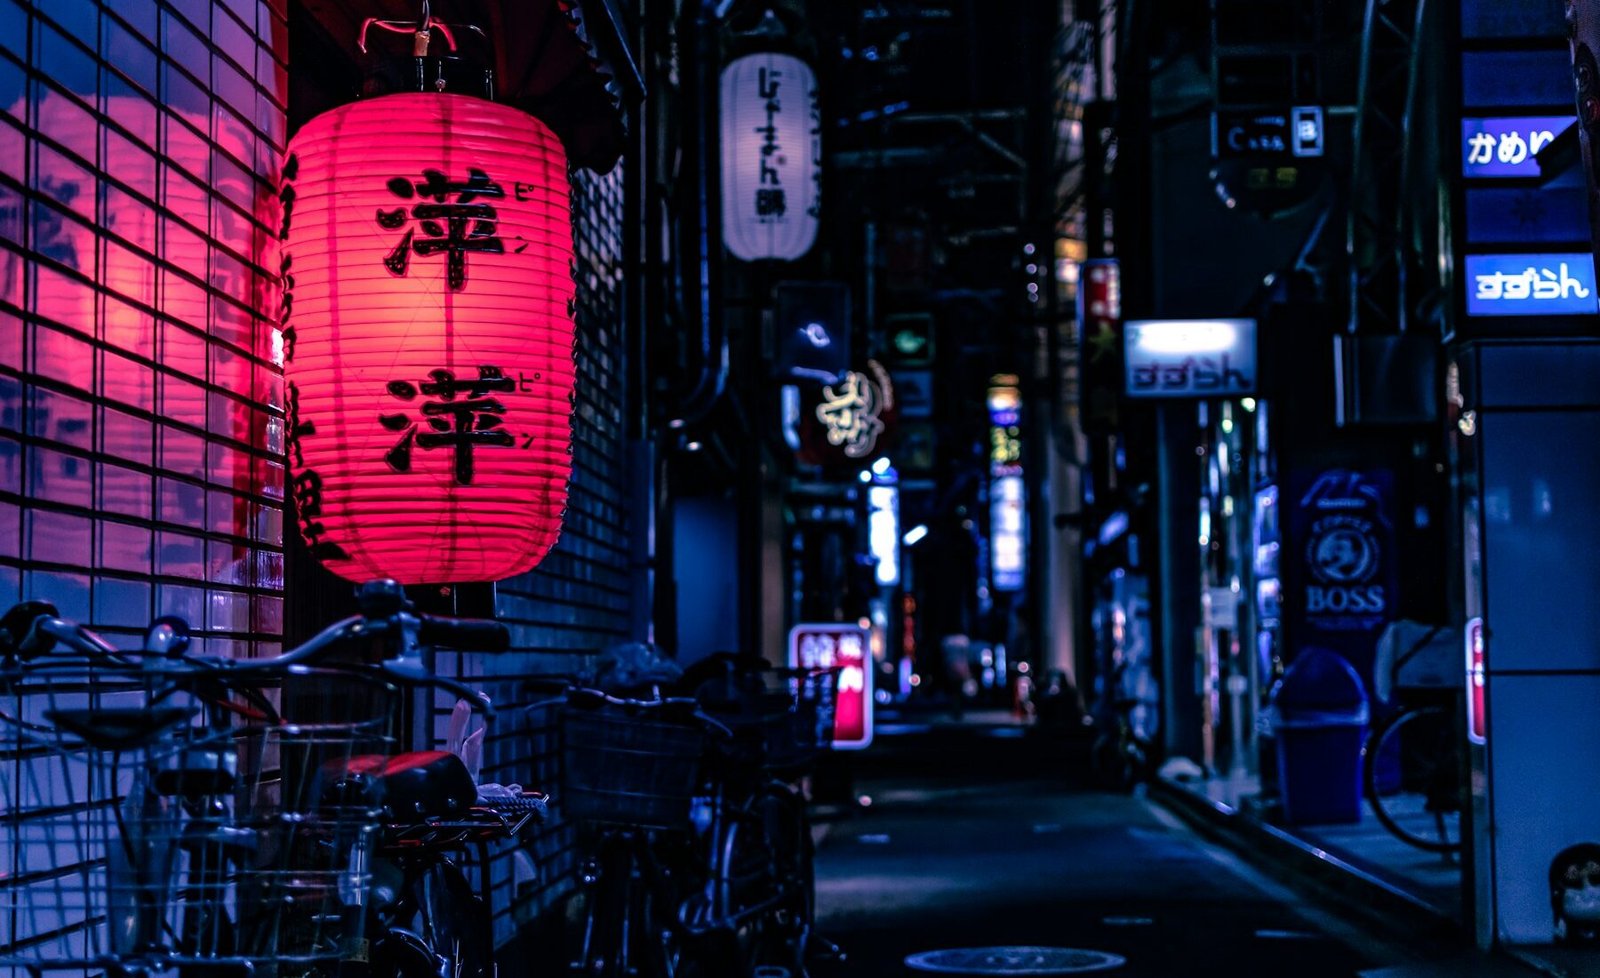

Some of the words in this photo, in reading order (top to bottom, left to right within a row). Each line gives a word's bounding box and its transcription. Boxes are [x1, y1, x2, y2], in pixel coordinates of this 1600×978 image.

[1475, 263, 1590, 300] すずらん
[1305, 583, 1386, 613] BOSS
